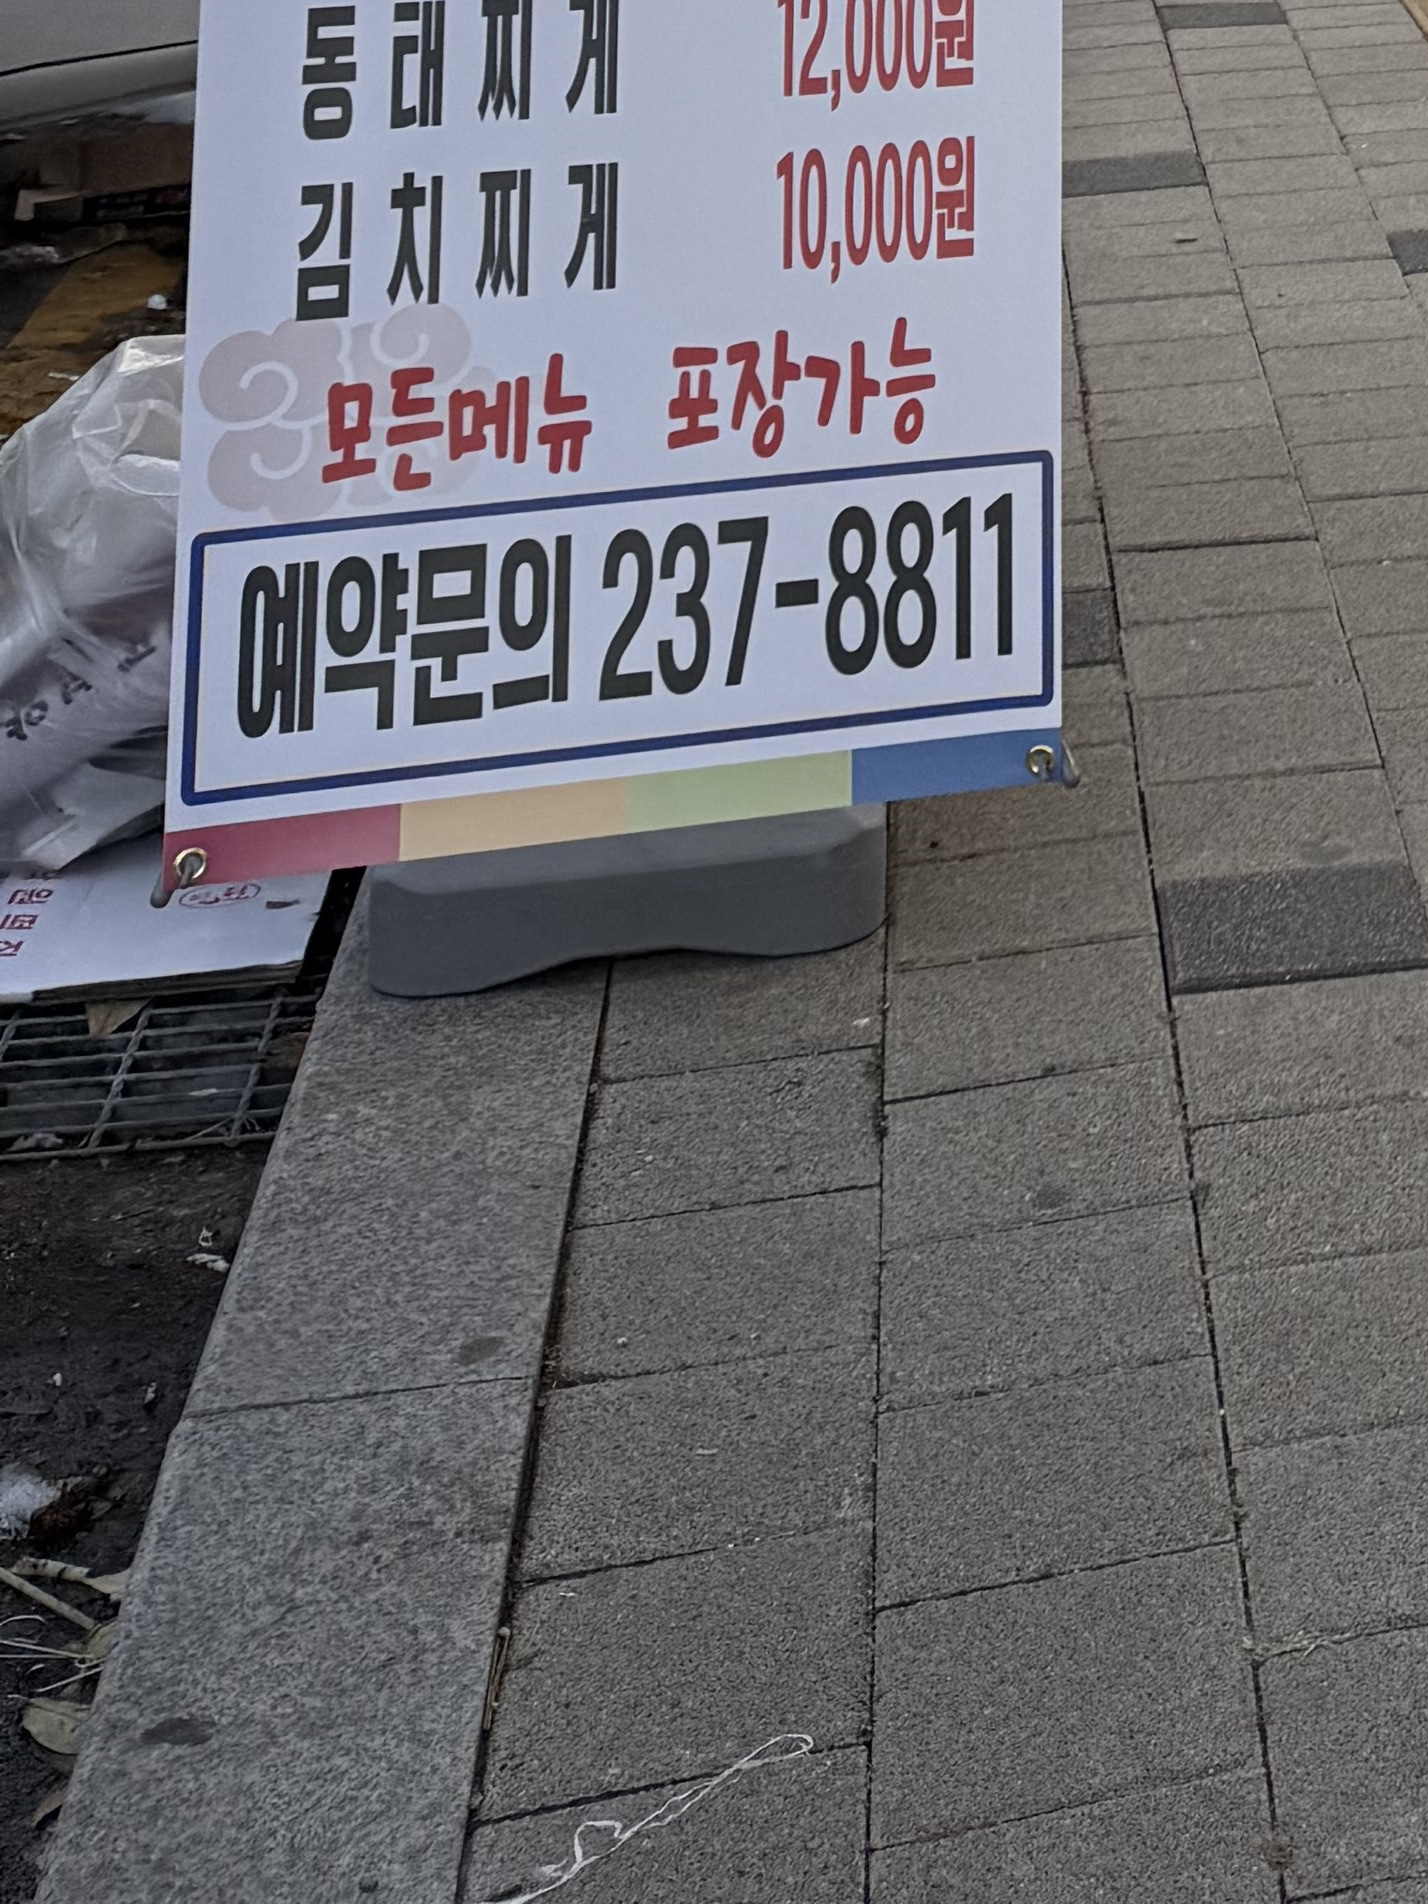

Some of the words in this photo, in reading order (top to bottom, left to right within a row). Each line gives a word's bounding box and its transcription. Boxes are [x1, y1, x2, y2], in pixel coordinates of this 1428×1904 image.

[294, 160, 621, 322] 김치찌게
[775, 134, 979, 287] 10,000원
[320, 351, 598, 492] 모든메뉴
[665, 315, 938, 454] 포장가능
[235, 533, 573, 741] 예약문의
[598, 493, 1016, 703] 237-8811
